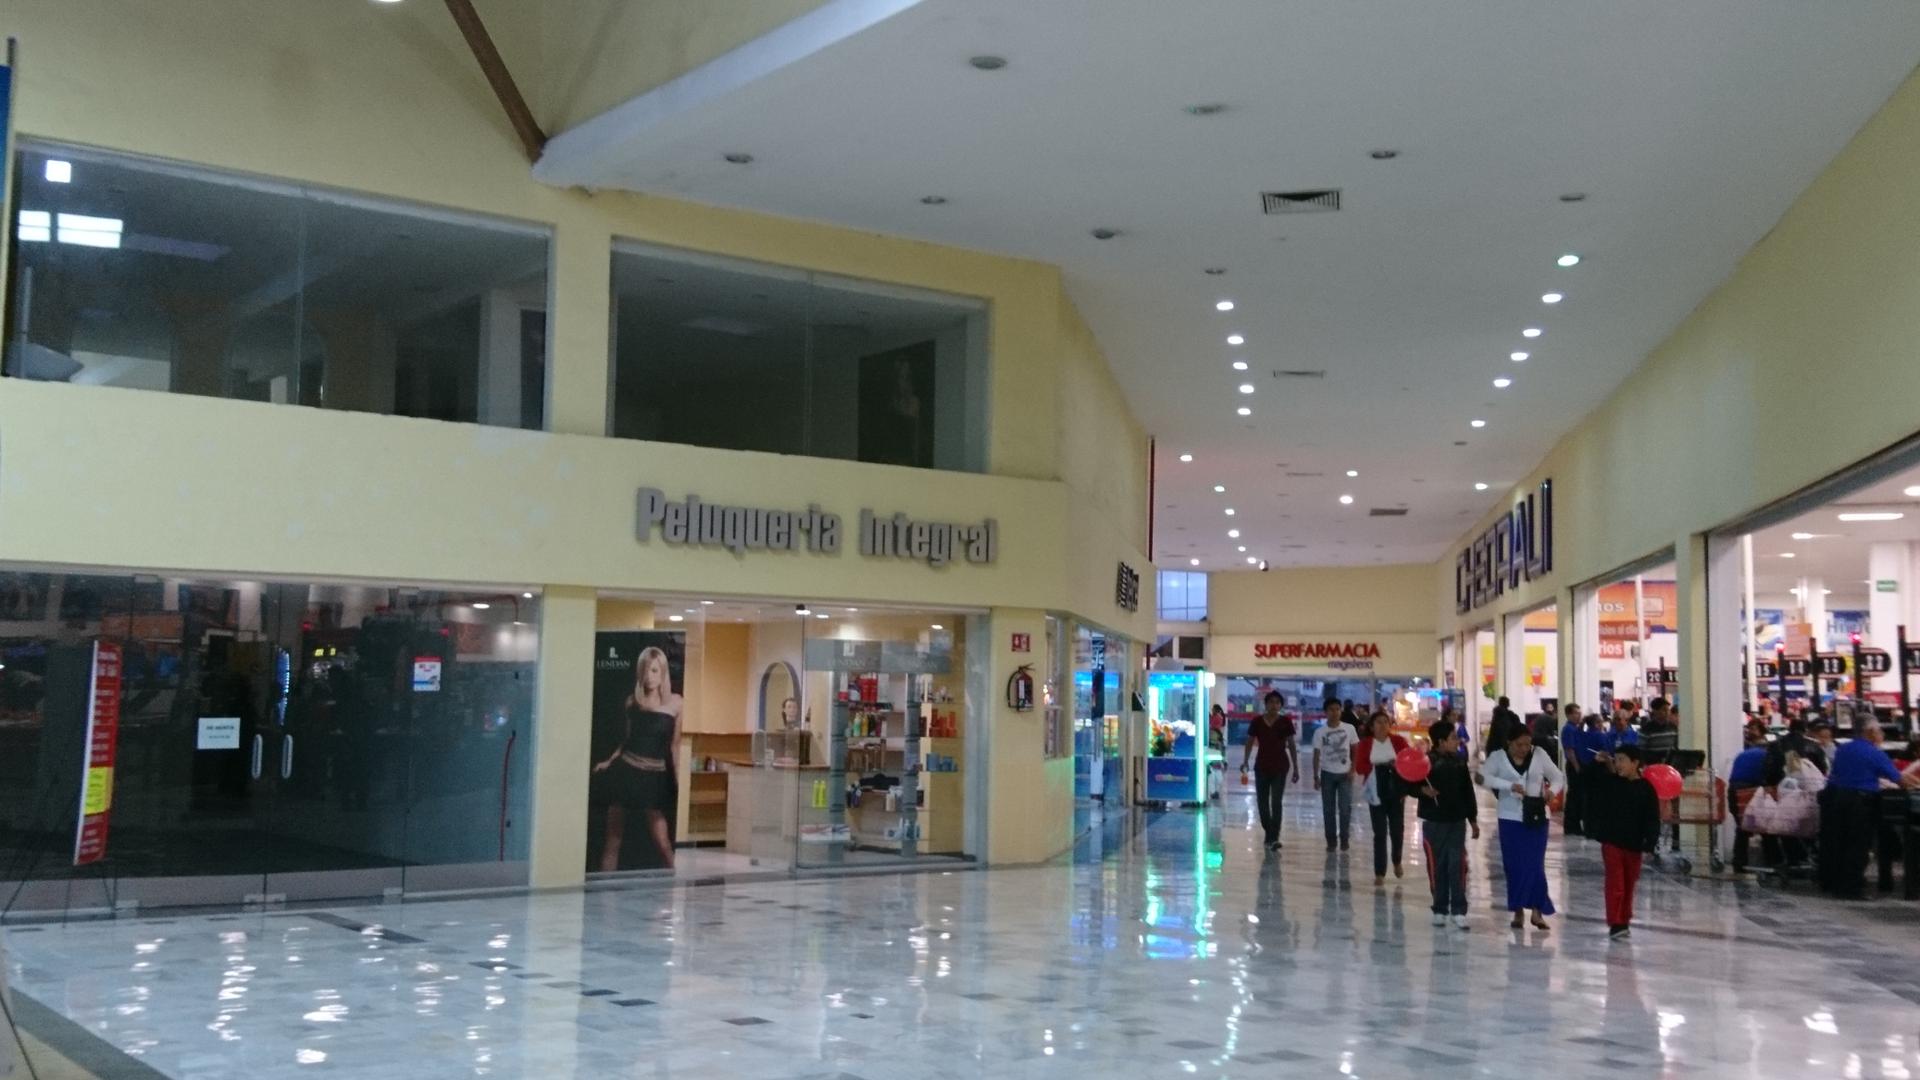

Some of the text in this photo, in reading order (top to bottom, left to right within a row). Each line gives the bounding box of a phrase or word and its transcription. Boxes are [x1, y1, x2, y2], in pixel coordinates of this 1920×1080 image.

[636, 486, 998, 568] Peluqueria Integral
[1254, 643, 1381, 659] SUPERFARMACIA
